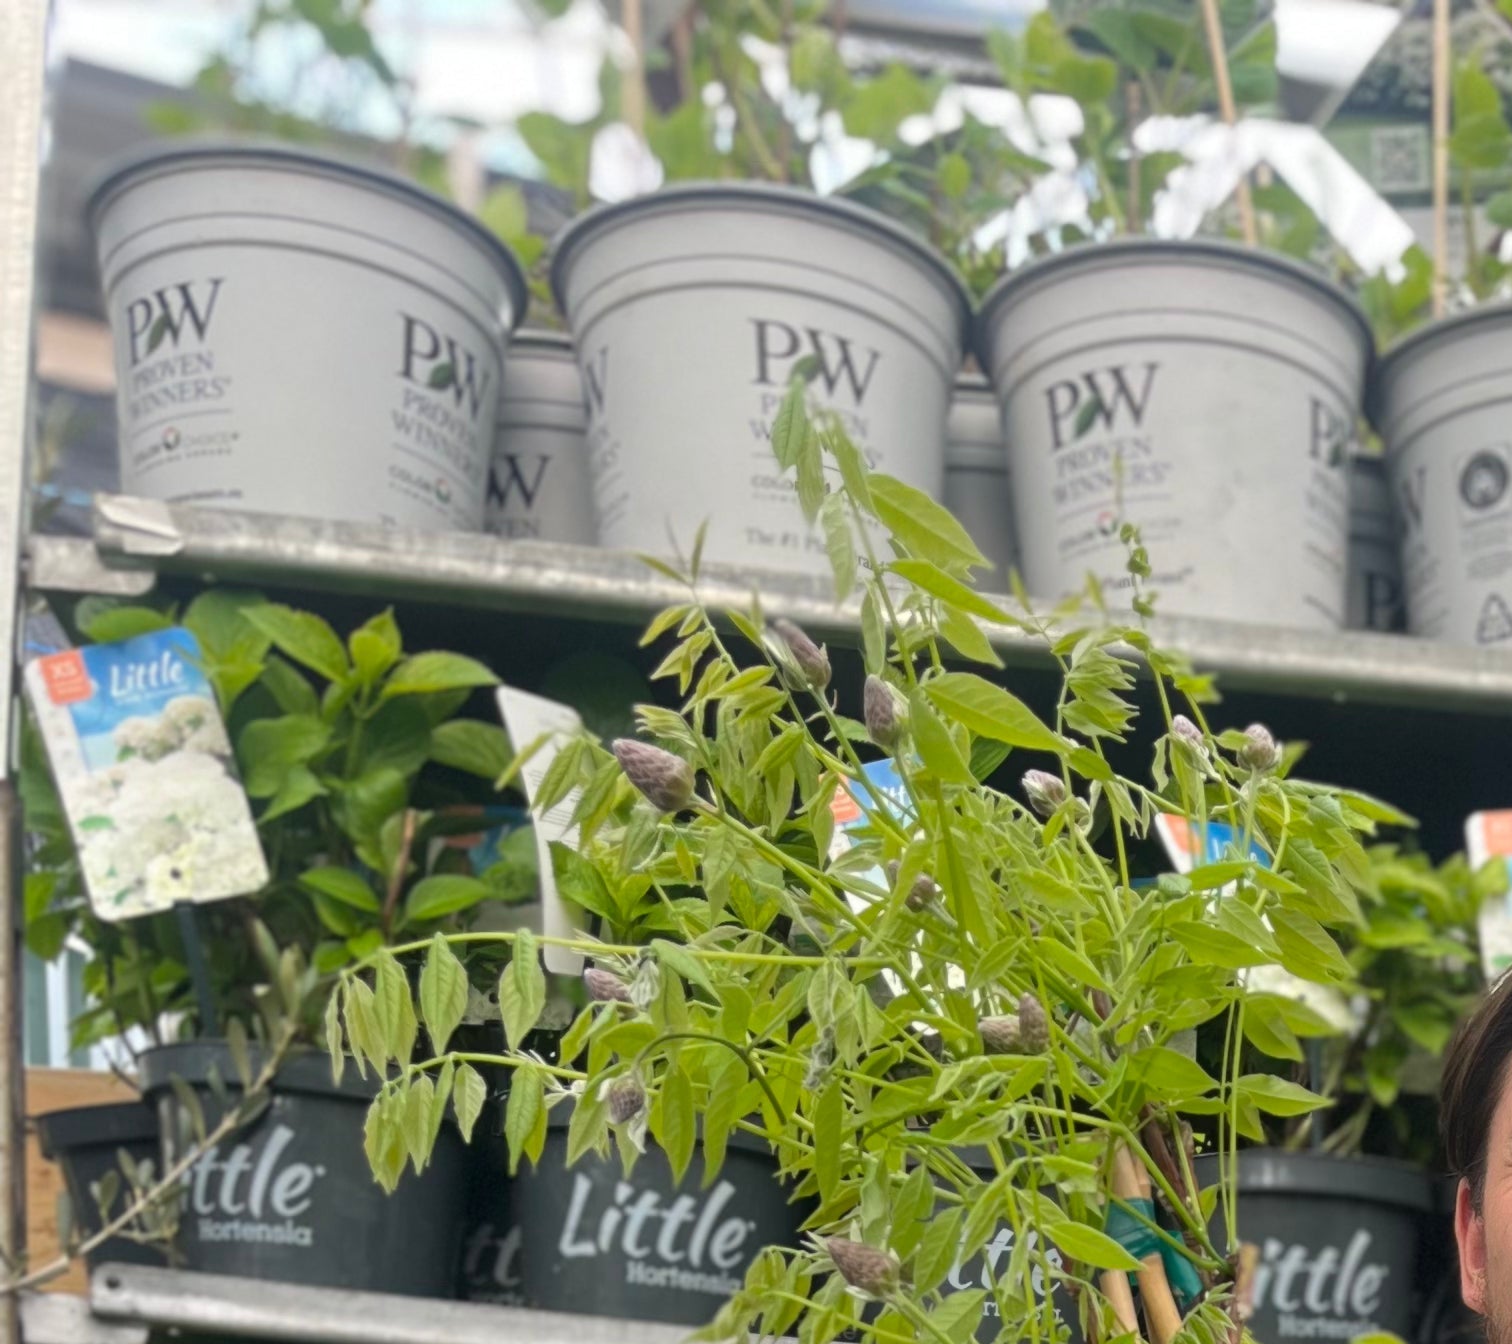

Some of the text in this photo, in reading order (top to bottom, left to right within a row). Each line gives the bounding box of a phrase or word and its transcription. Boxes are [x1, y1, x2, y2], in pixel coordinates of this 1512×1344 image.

[110, 650, 184, 697] Little
[184, 1125, 313, 1220] ttle
[558, 1173, 747, 1270] Little
[1253, 1228, 1384, 1317] ittle
